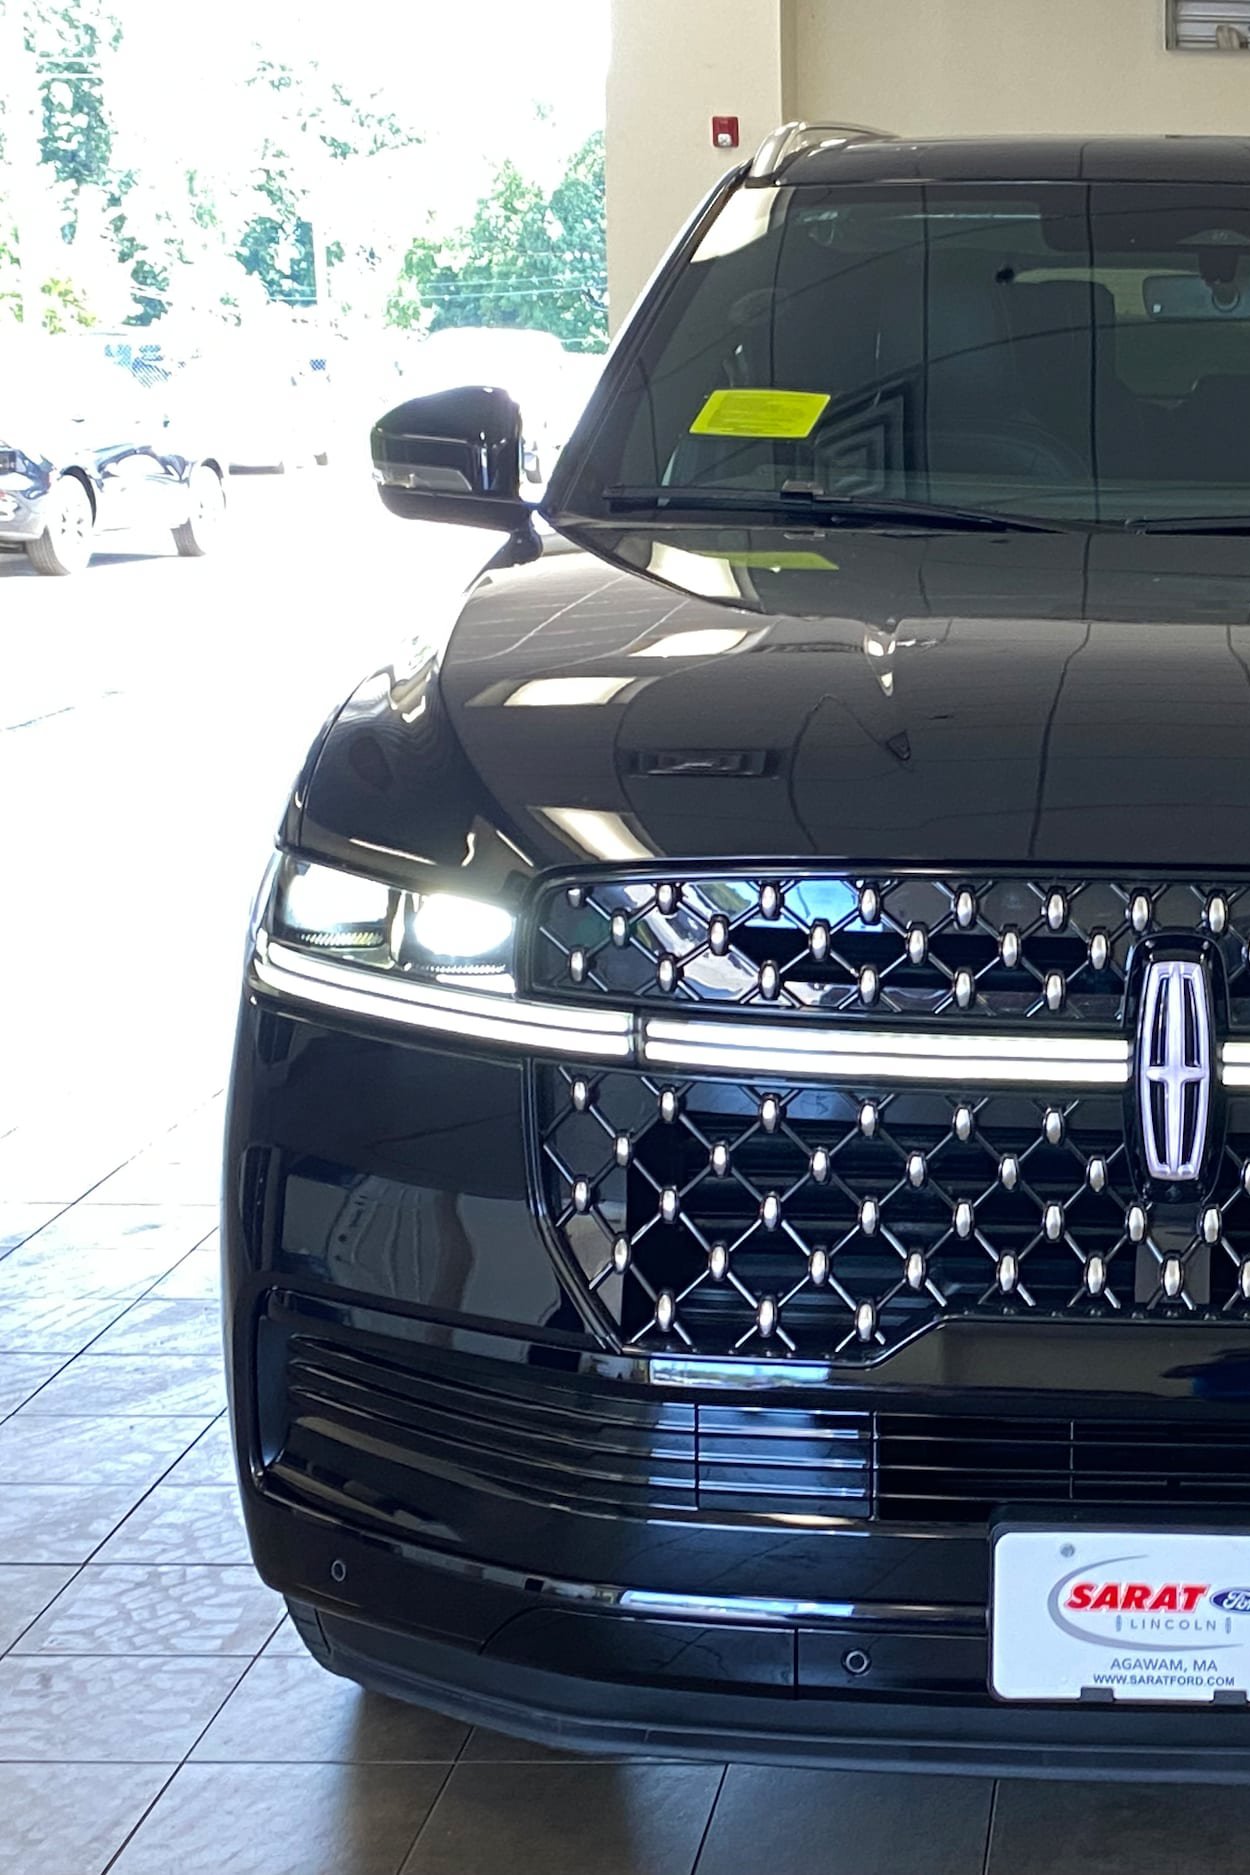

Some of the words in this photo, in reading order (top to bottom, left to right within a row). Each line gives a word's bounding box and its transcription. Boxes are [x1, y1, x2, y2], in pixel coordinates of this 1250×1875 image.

[1065, 1583, 1209, 1613] SARAT
[1130, 1618, 1217, 1631] LINCOLN
[1110, 1657, 1188, 1673] AGAWAM,
[1193, 1659, 1218, 1672] MA
[1093, 1674, 1235, 1687] WWW.SARATFORD.COM
